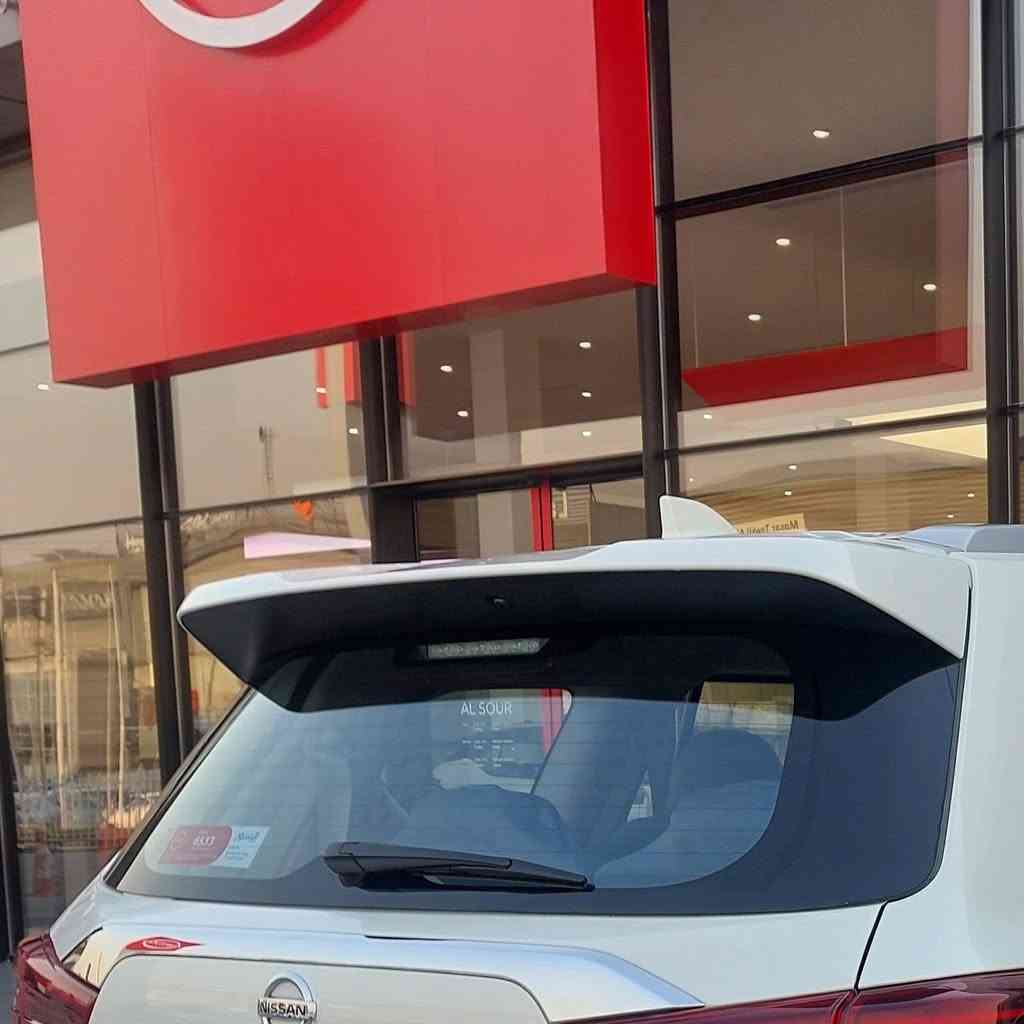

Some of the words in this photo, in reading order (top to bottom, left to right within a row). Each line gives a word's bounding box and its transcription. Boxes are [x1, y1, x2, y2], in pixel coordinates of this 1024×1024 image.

[461, 701, 476, 715] AL
[479, 701, 512, 716] SOUR
[258, 999, 307, 1017] NISSAN
